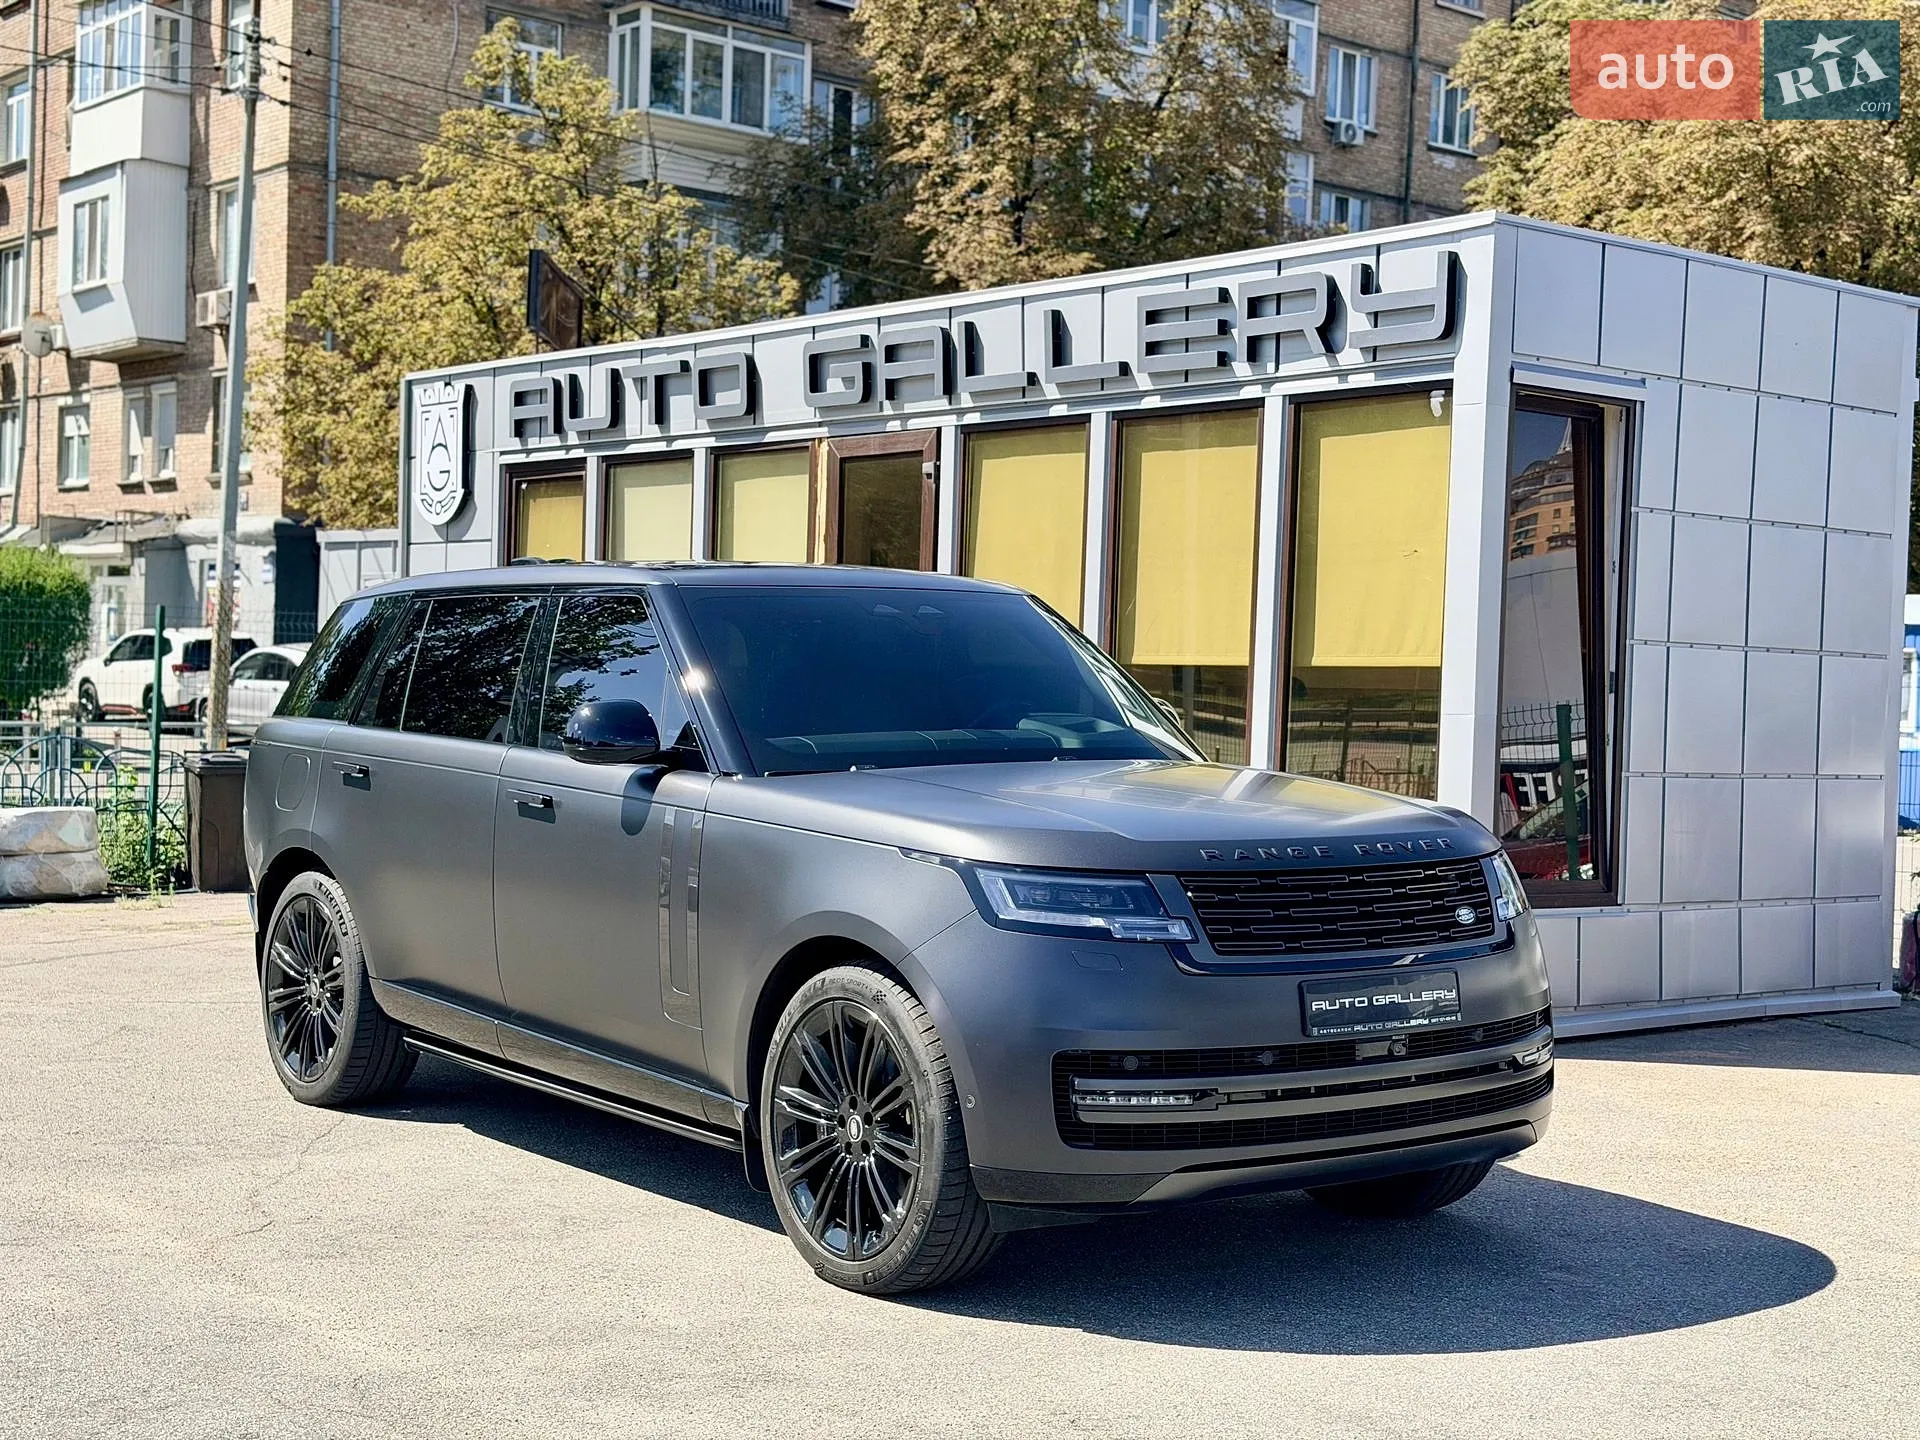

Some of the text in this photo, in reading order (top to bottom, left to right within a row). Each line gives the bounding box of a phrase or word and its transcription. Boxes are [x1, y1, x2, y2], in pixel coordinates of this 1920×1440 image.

[509, 251, 1457, 438] AUTO GALLERY
[1200, 837, 1455, 862] RANGE ROVER
[1312, 988, 1456, 1011] AUTO GALLERY
[1354, 1023, 1383, 1032] AUTO
[1385, 1018, 1430, 1029] GALLERY
